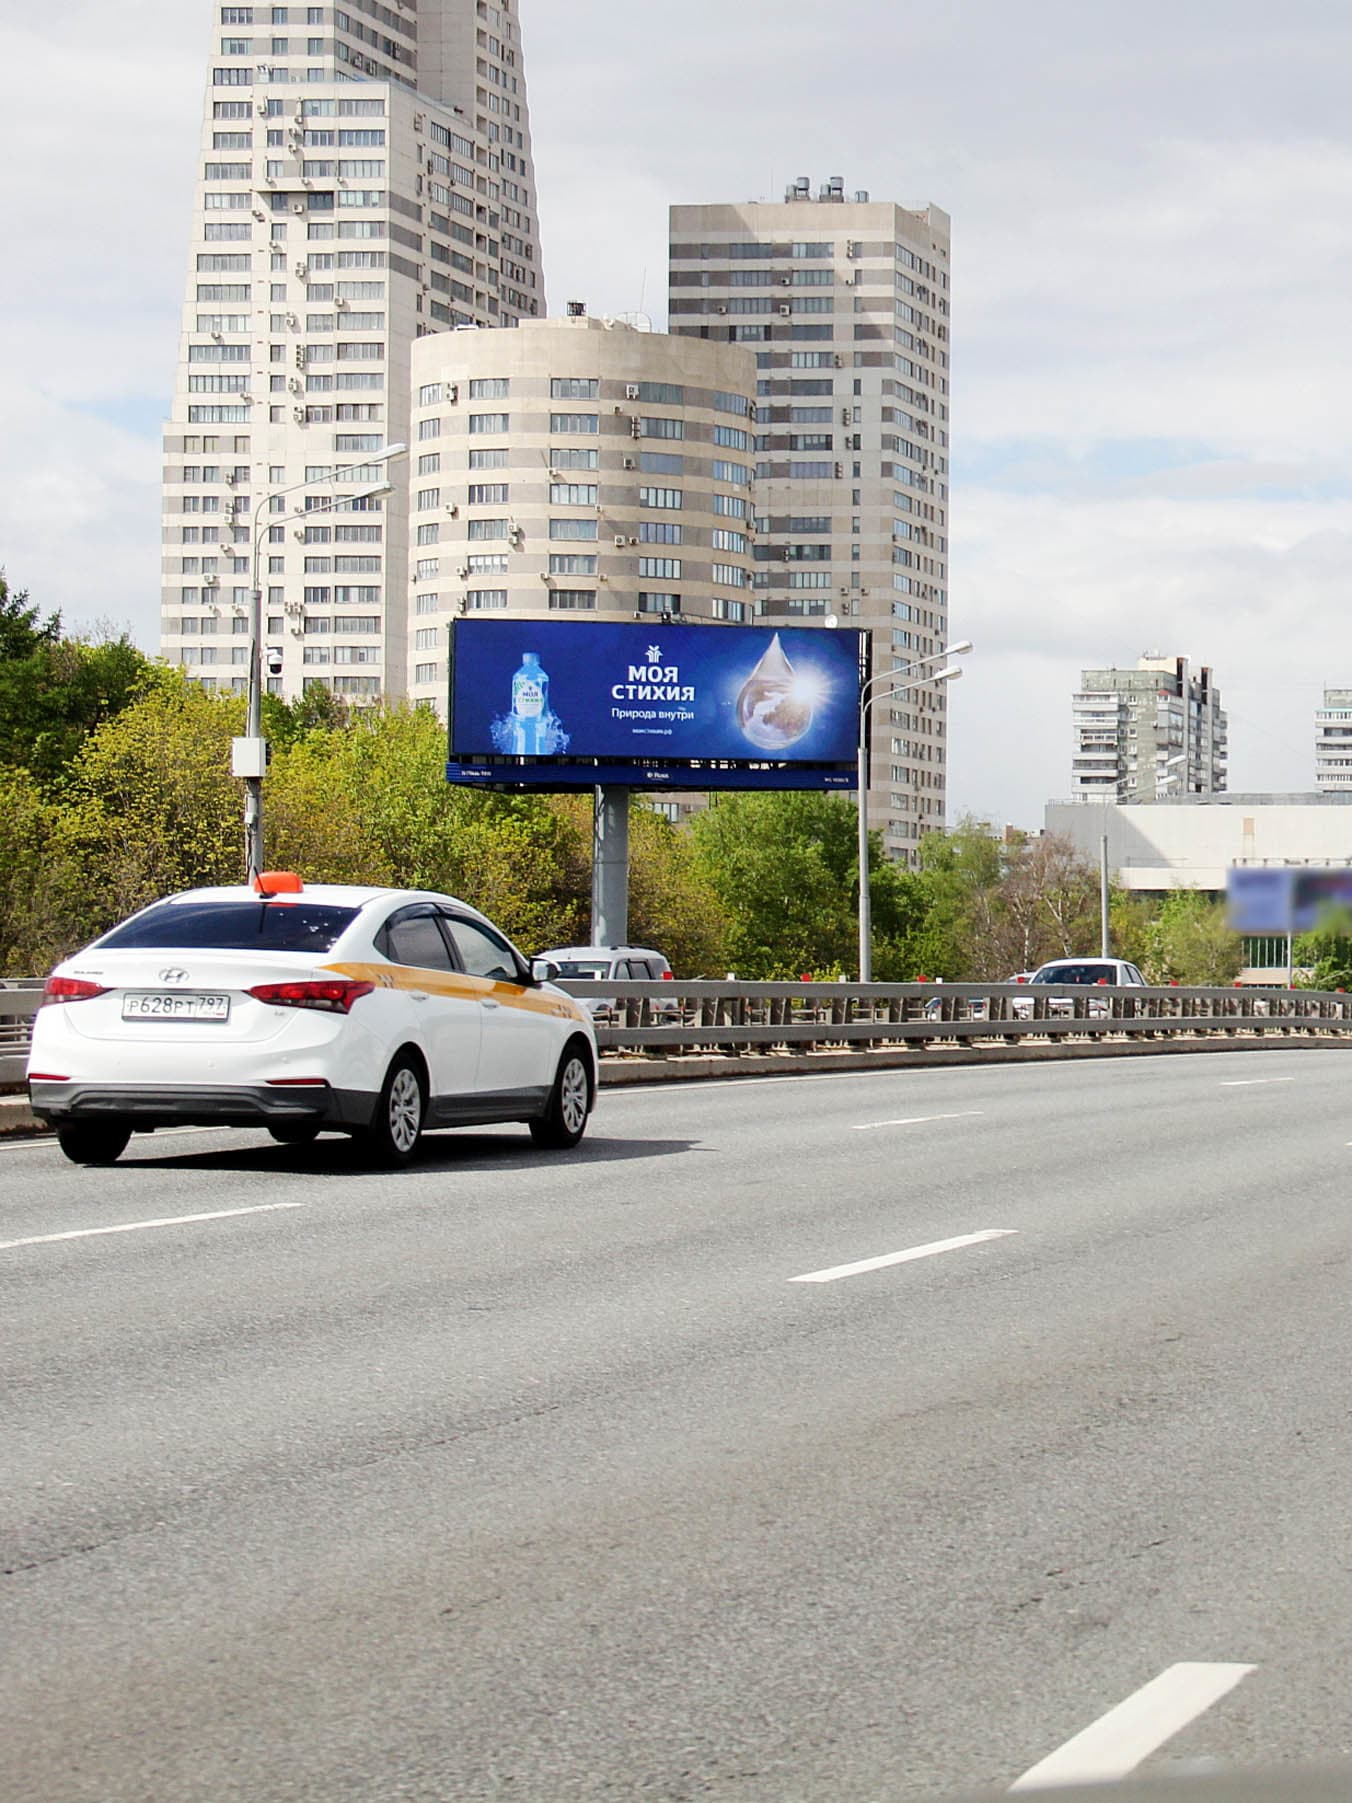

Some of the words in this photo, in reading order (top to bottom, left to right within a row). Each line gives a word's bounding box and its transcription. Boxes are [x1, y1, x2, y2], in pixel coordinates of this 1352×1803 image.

[628, 665, 679, 683] МОЯ
[611, 684, 695, 702] СТИХИЯ
[611, 707, 657, 720] Природа
[658, 710, 695, 722] внутри
[199, 997, 224, 1010] 797
